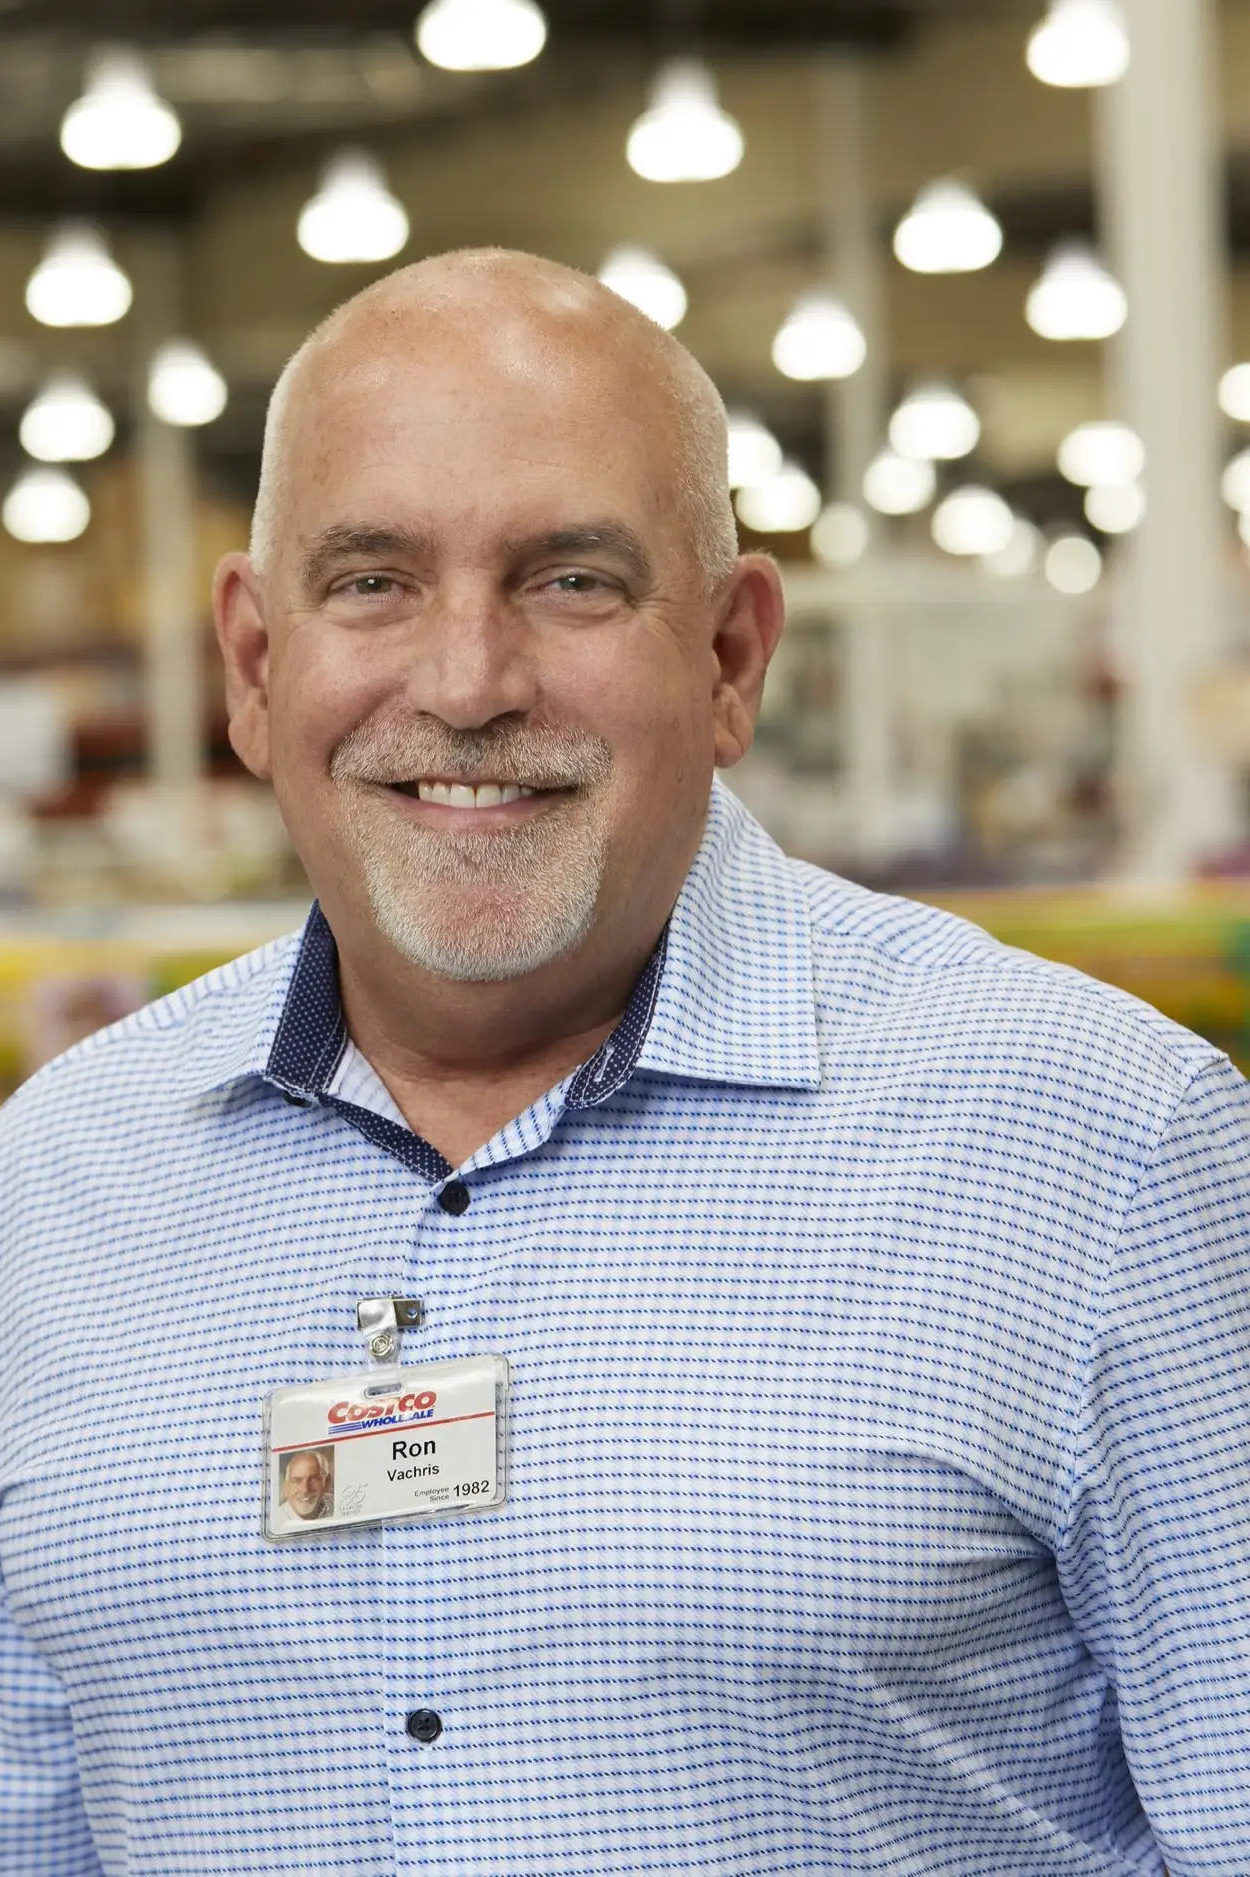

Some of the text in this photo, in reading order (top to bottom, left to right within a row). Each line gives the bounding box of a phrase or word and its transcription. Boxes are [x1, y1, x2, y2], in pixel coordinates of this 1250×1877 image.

[361, 1409, 434, 1429] WHOLALE
[393, 1440, 435, 1460] Ron
[387, 1464, 440, 1481] Vachris
[414, 1487, 450, 1497] Employee
[453, 1480, 490, 1497] 1982
